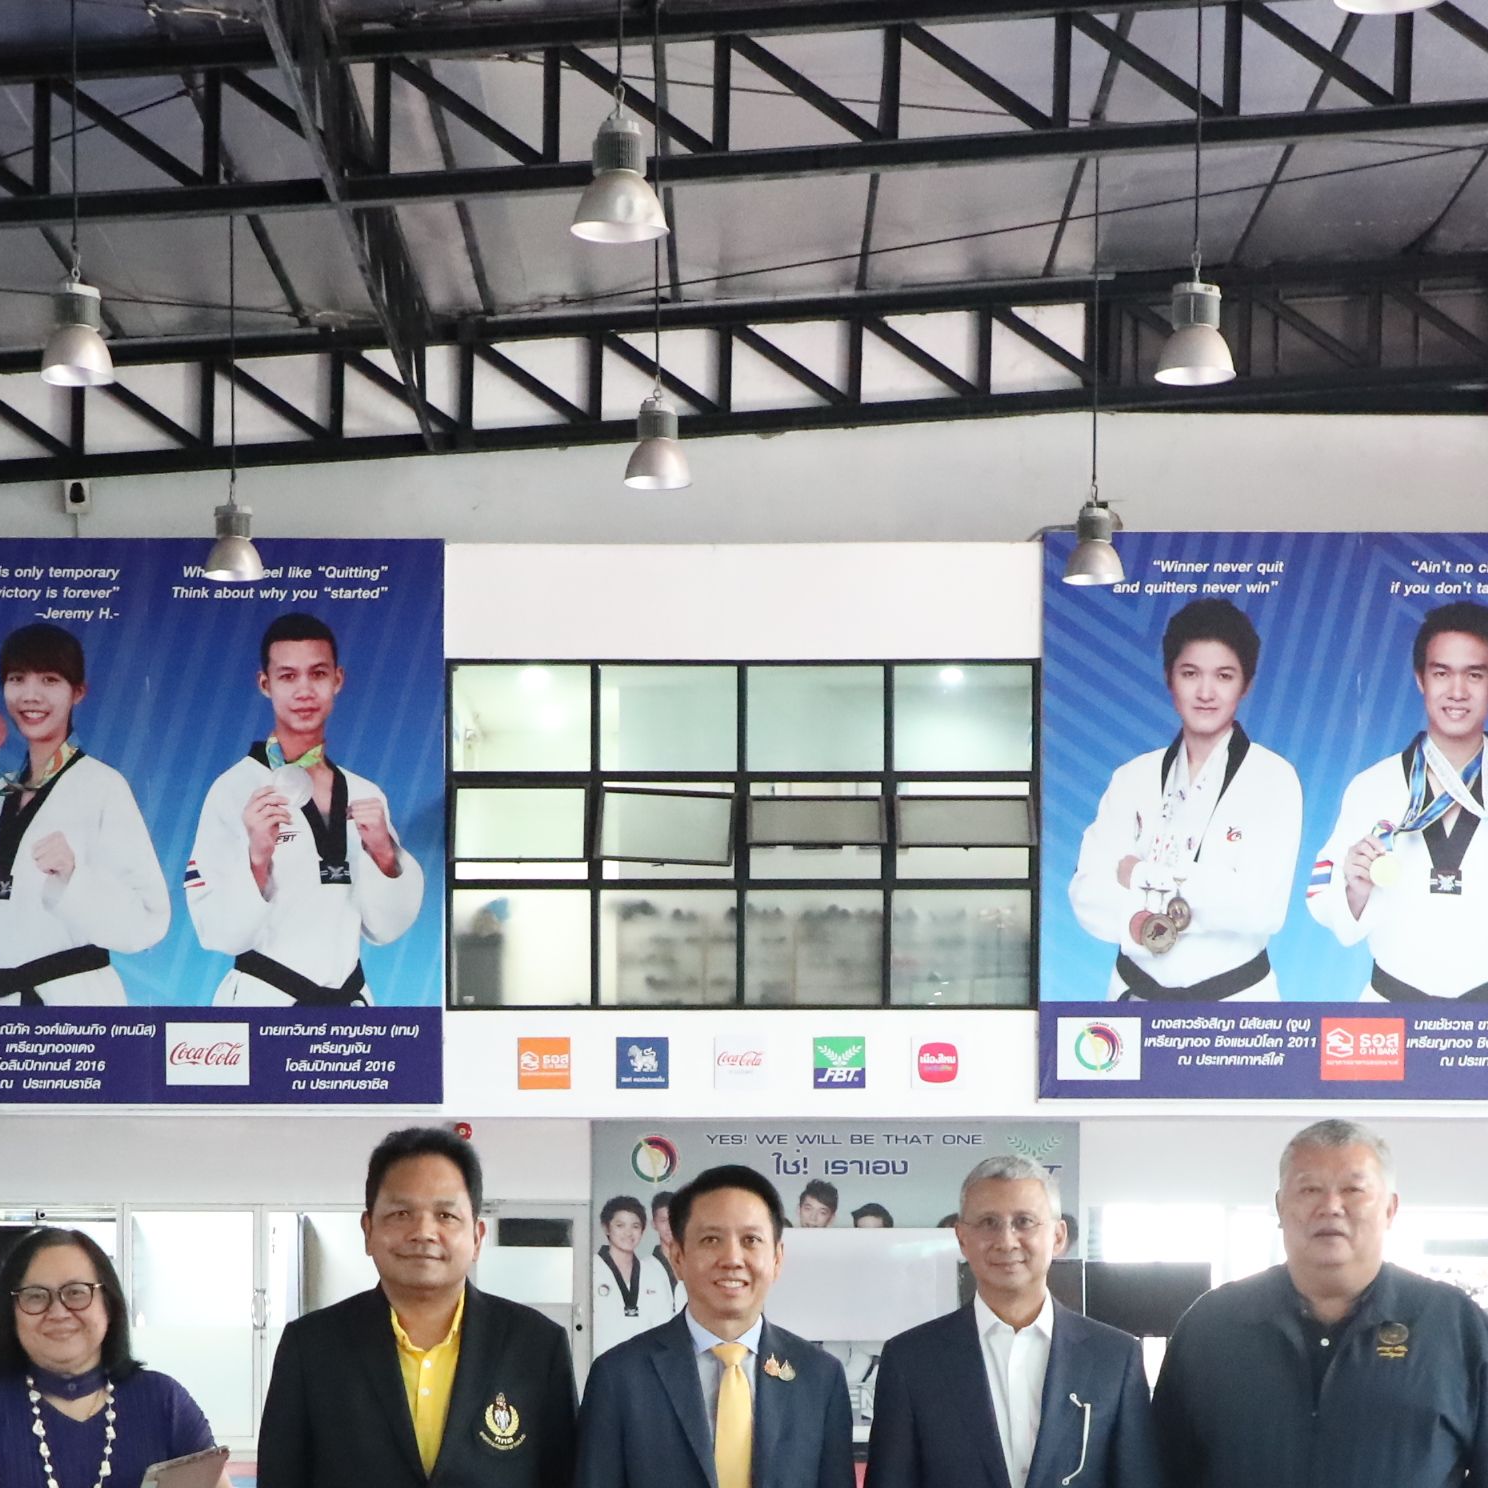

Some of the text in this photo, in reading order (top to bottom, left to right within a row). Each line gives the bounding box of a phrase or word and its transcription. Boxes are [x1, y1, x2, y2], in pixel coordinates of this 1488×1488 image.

[14, 566, 44, 580] only
[49, 566, 120, 581] temporary
[183, 566, 388, 581] Wh eel like “Quitting”
[1153, 560, 1284, 575] “Winner never quit
[1411, 560, 1451, 573] “Ain’t
[1455, 563, 1474, 573] no
[46, 587, 58, 598] is
[63, 586, 120, 599] forever”
[172, 586, 388, 602] Think about why you “started”
[1114, 580, 1279, 596] and quitters never win”
[1390, 581, 1401, 594] if
[1403, 584, 1430, 597] you
[1435, 581, 1472, 594] don’t
[35, 607, 119, 622] –Jeremy H.-
[5, 1041, 95, 1055] เหรียญทองแดง
[309, 1041, 371, 1056] เหรียญเงิน
[1144, 1034, 1211, 1049] เหรียญทอง
[1287, 1036, 1316, 1048] 2011
[170, 1042, 244, 1066] Coca-Cola
[1178, 1055, 1192, 1065] ณ
[75, 1060, 106, 1071] 2016
[285, 1058, 396, 1072] โอลิมปิกเกมส์ 2016
[817, 1067, 863, 1082] FBT
[0, 1079, 14, 1089] ณ
[292, 1080, 306, 1090] ณ
[706, 1134, 986, 1145] YES! WE WILL BE THAT ONE.
[772, 1149, 908, 1175] ใช่! เราเอง
